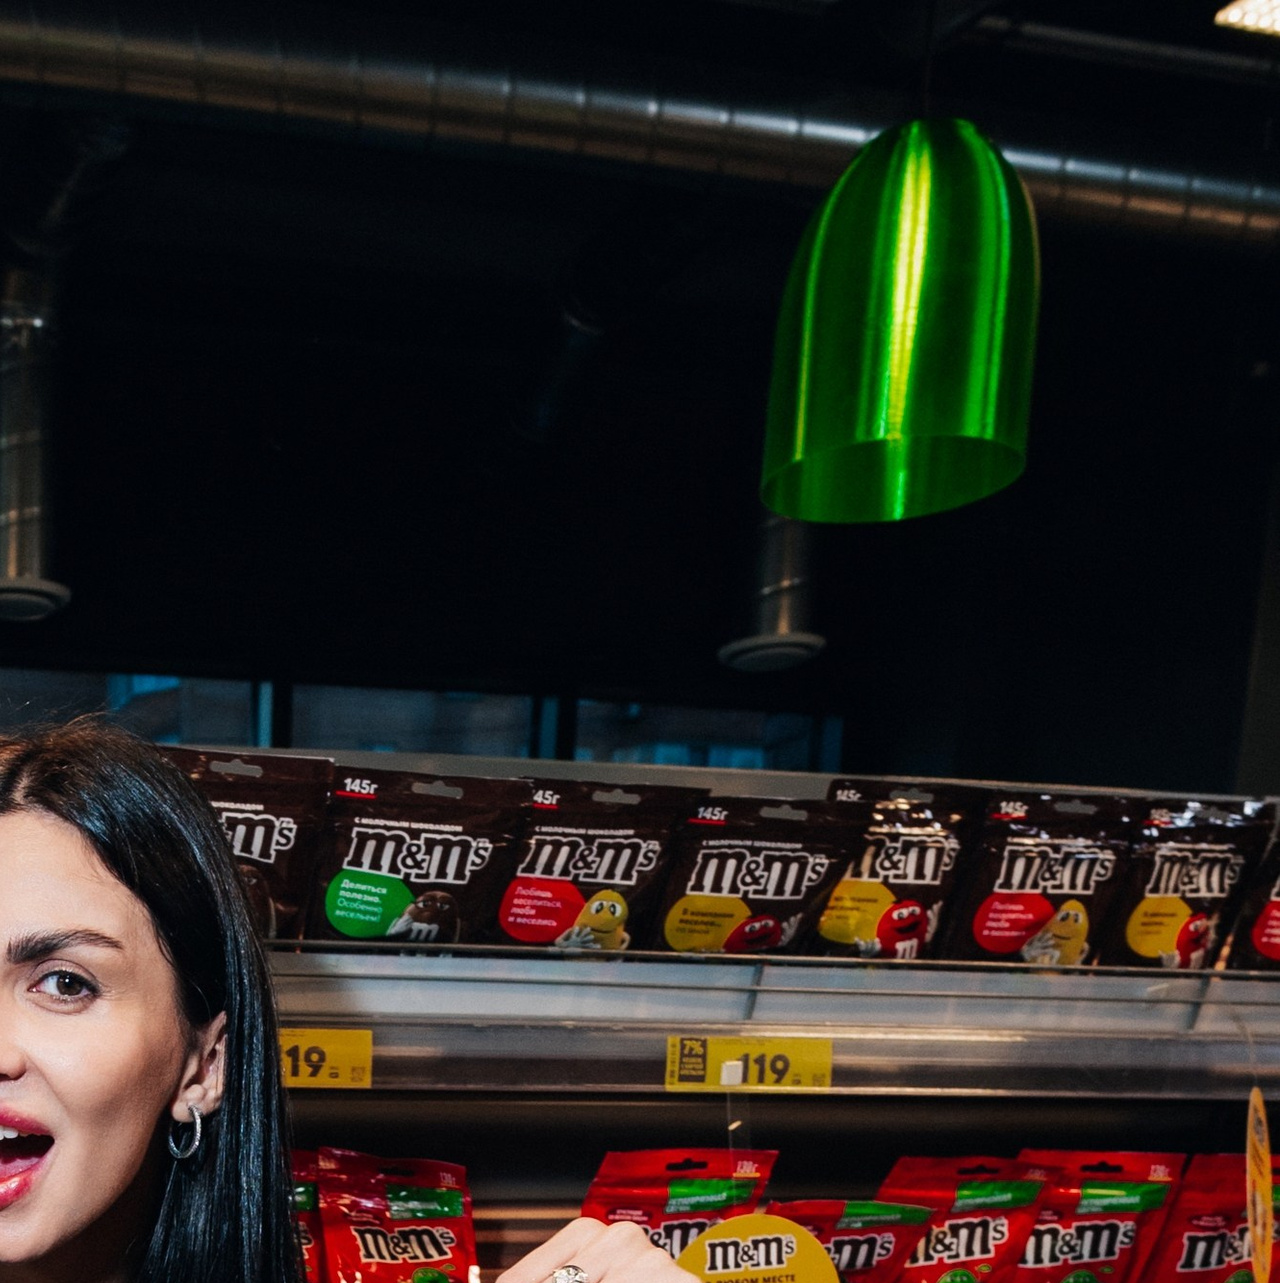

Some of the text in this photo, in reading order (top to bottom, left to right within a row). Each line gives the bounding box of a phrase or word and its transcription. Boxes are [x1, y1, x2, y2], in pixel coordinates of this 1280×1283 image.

[343, 776, 379, 794] 145г
[533, 788, 561, 806] 45г
[697, 806, 729, 821] 145г
[342, 827, 494, 885] m&m's
[516, 835, 661, 886] m&m's
[685, 848, 830, 900] m&m's
[993, 844, 1117, 895] m&m's
[1144, 850, 1245, 898] m&m's
[738, 1053, 791, 1084] 119
[350, 1226, 457, 1263] m&m's
[705, 1234, 797, 1275] m&m's
[903, 1215, 1010, 1270] m&m's
[1017, 1219, 1138, 1267] m&m's
[762, 1274, 796, 1283] МЕСТЕ
